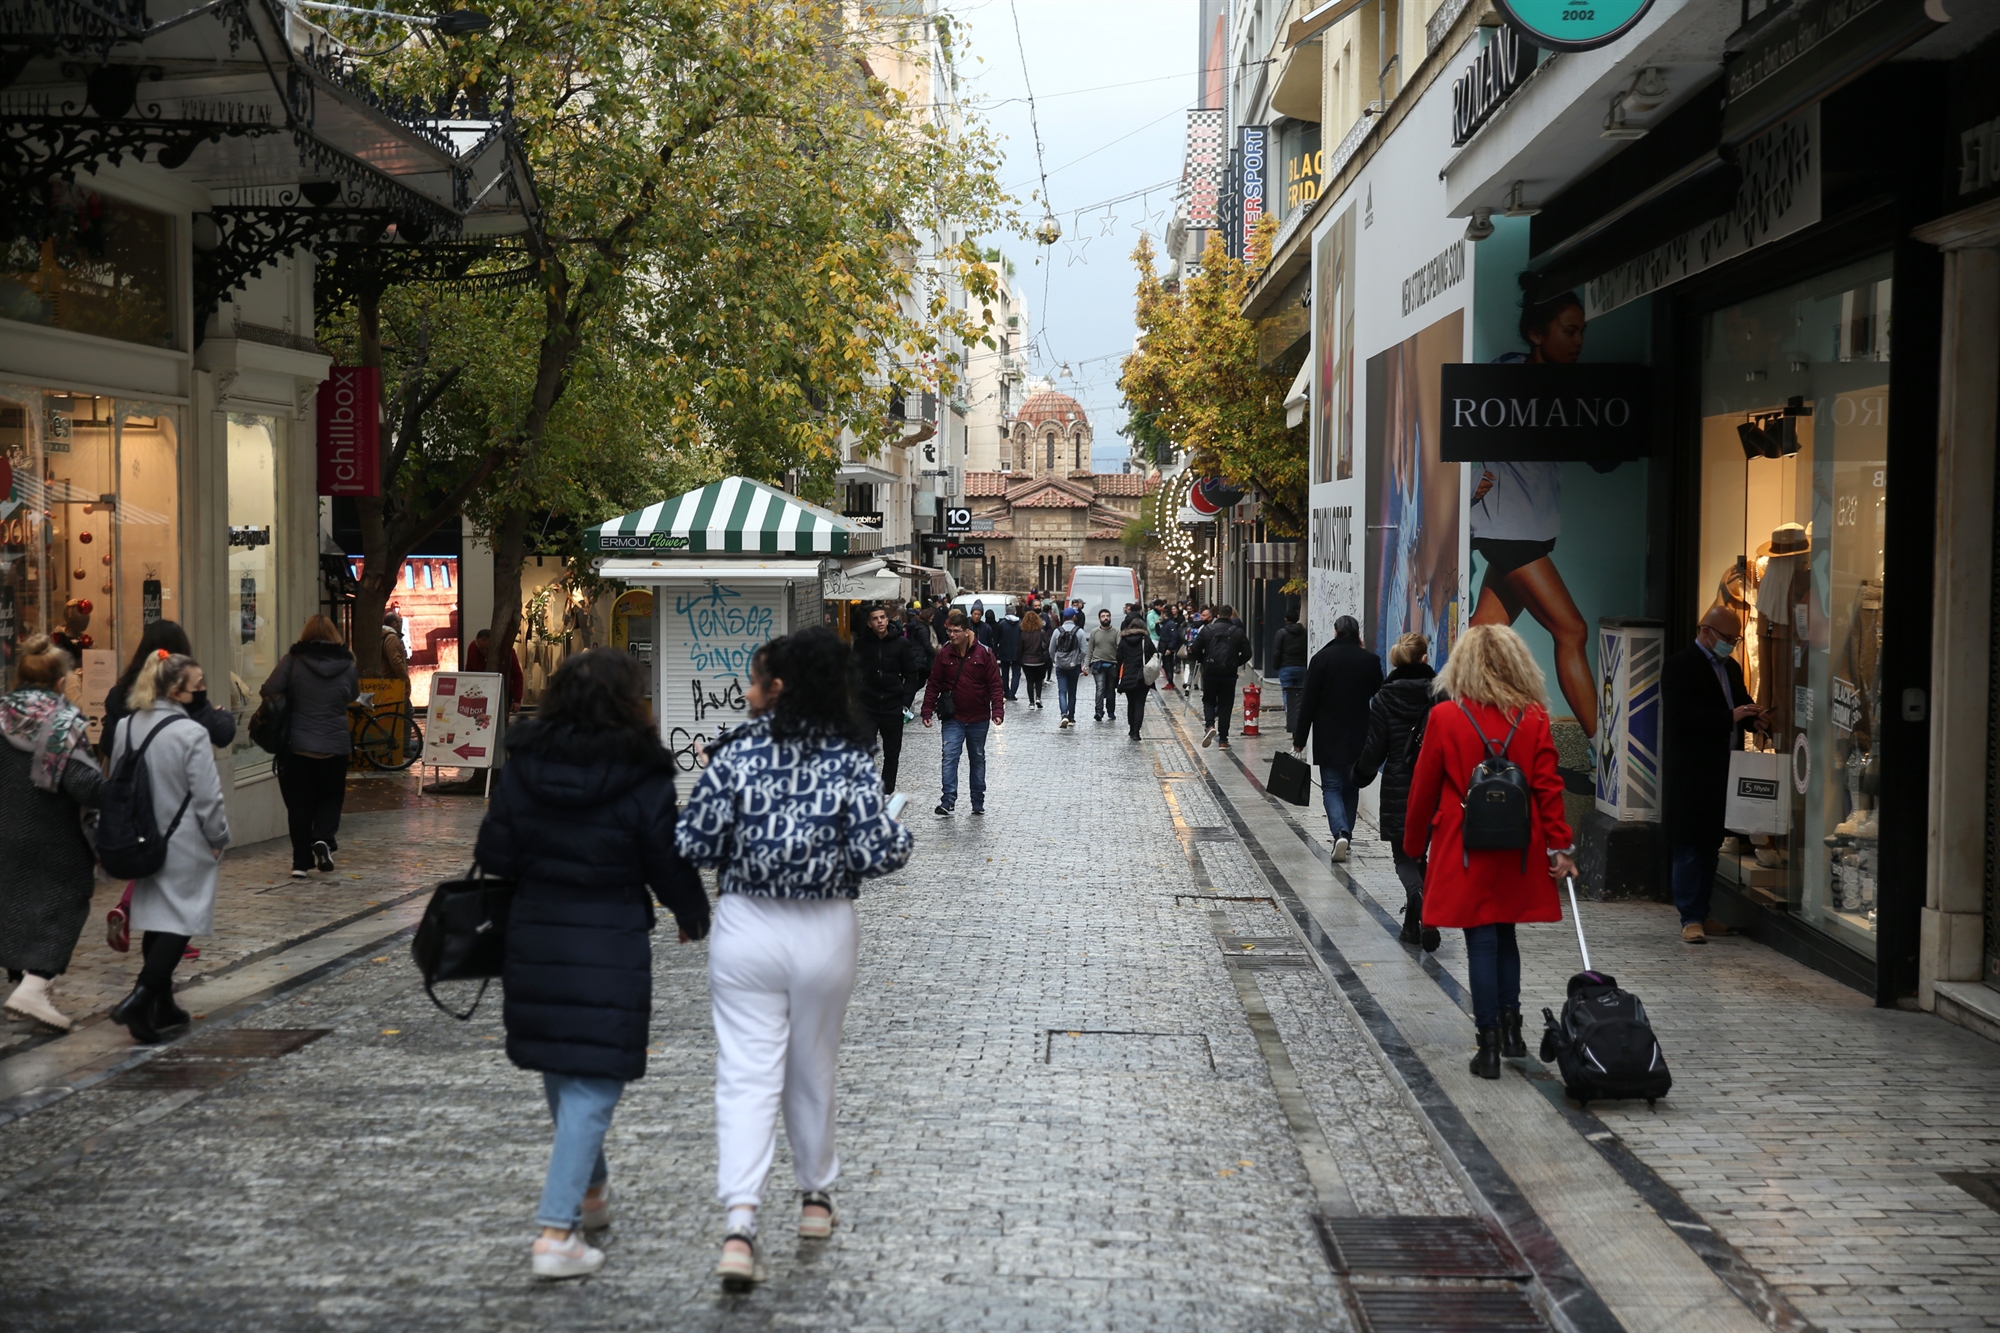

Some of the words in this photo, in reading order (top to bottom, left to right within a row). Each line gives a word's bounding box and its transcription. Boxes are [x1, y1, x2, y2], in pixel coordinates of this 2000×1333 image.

[1562, 10, 1595, 21] 2002
[1451, 24, 1519, 147] ROMANO
[1288, 149, 1322, 184] BLAC
[1243, 128, 1263, 262] INTERSPORT
[1411, 264, 1426, 312] STORE
[1426, 248, 1448, 302] OPENING
[1448, 238, 1465, 289] SOON
[329, 371, 355, 480] chillbox
[1452, 397, 1632, 428] ROMANO
[356, 428, 365, 453] yogurt
[947, 509, 971, 525] 10
[601, 537, 646, 548] ERMOU
[647, 533, 689, 548] Flower
[1313, 506, 1332, 571] ERMOU
[1332, 505, 1352, 573] STORE
[1834, 683, 1851, 705] BLACK
